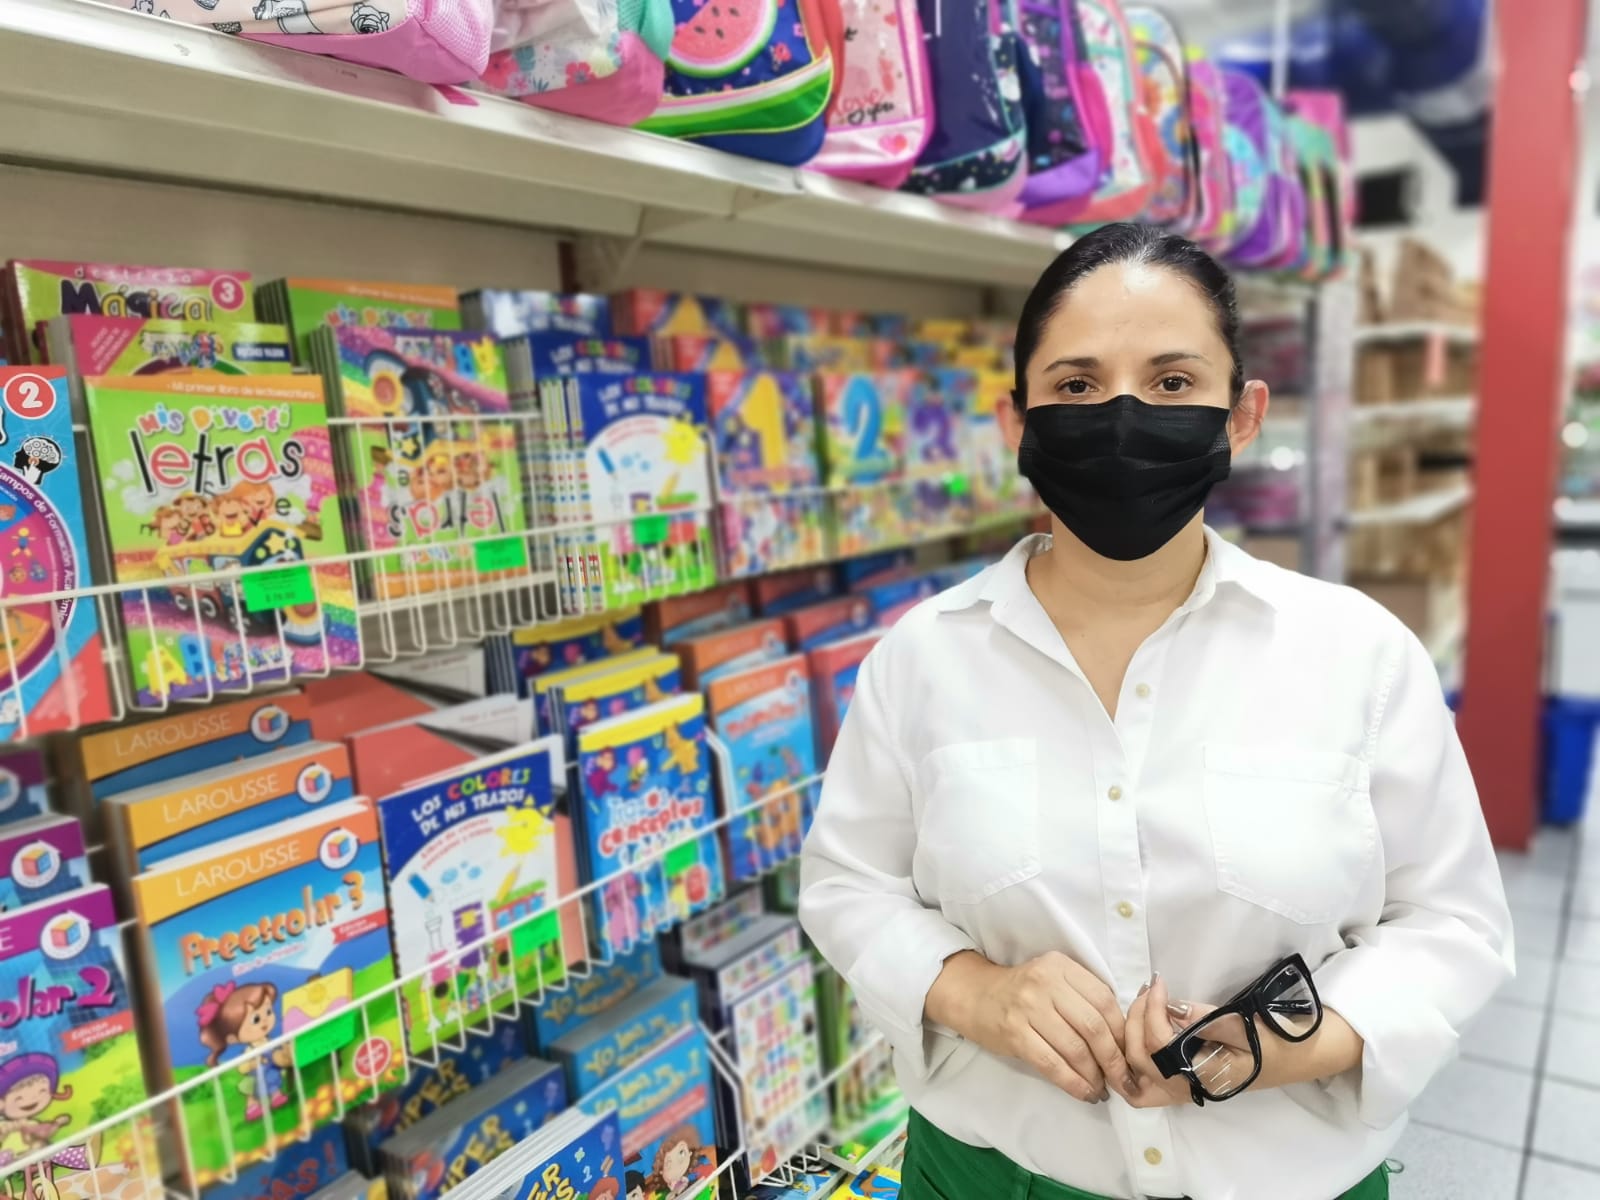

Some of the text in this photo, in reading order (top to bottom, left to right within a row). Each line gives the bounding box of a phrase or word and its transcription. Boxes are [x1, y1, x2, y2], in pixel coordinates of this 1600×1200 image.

[219, 282, 236, 303] 3
[18, 381, 43, 409] 2
[138, 402, 290, 435] Mis Diverti
[841, 375, 890, 485] 2
[129, 430, 303, 495] letras
[0, 469, 34, 501] ampos
[34, 498, 47, 514] de
[115, 713, 233, 757] LAROUSSE
[163, 775, 280, 824] LAROUSSE
[411, 768, 531, 822] LOS COLORES
[419, 788, 527, 837] DE MIS TRAZOS
[175, 840, 302, 897] LAROUSSE
[180, 884, 342, 976] Preescolar
[342, 870, 365, 911] 3
[77, 966, 116, 1008] 2
